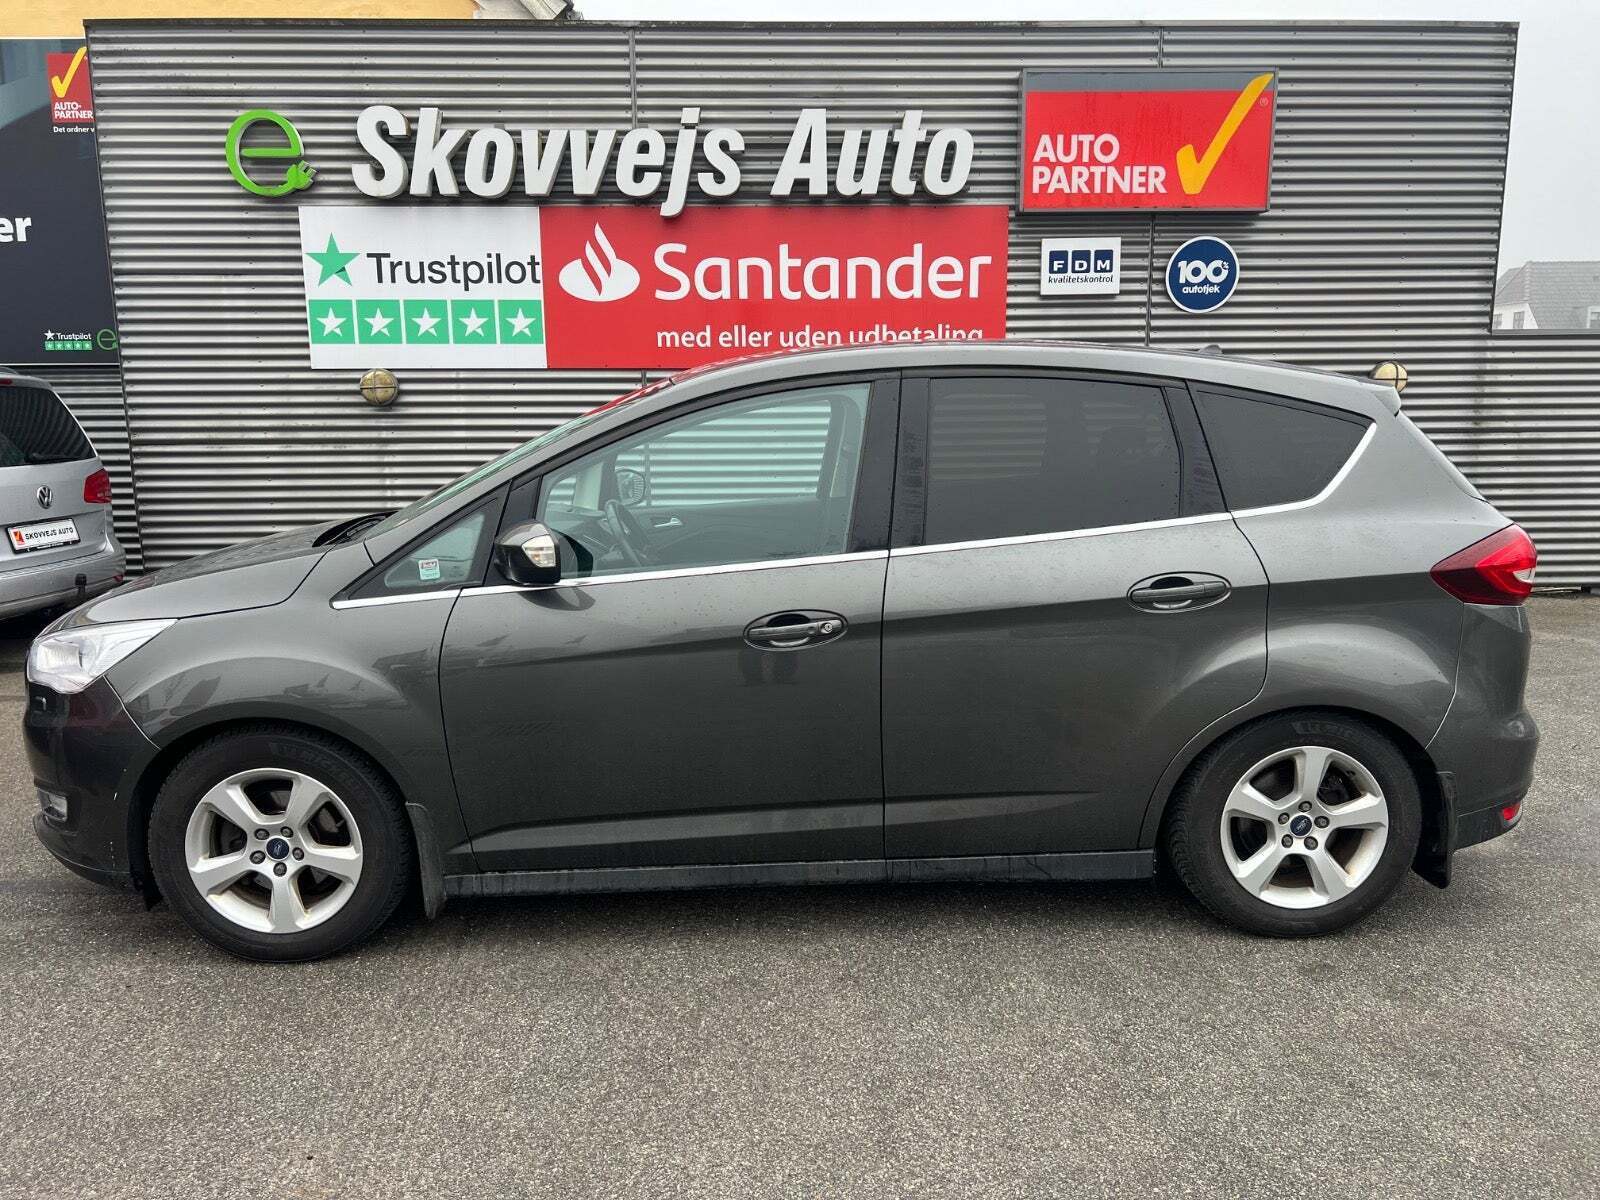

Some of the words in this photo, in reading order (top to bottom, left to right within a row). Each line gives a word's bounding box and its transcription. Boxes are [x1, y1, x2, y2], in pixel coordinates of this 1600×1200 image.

[54, 102, 82, 111] AUTO-
[54, 110, 94, 119] PARTNER
[66, 125, 90, 133] ordner
[1032, 133, 1120, 164] AUTO
[351, 105, 745, 218] Skovvejs
[769, 108, 975, 197] Auto
[1031, 165, 1168, 194] PARTNER
[366, 252, 542, 292] Trustpilot
[653, 243, 992, 301] Santander
[1048, 275, 1114, 284] kvalitetskontrol
[1182, 284, 1221, 294] autotjek
[56, 332, 92, 341] Trustpilot
[656, 324, 712, 348] med
[718, 324, 773, 348] eller
[779, 324, 842, 348] uden
[25, 528, 58, 540] SKOVVEJS
[58, 526, 74, 535] AUTO
